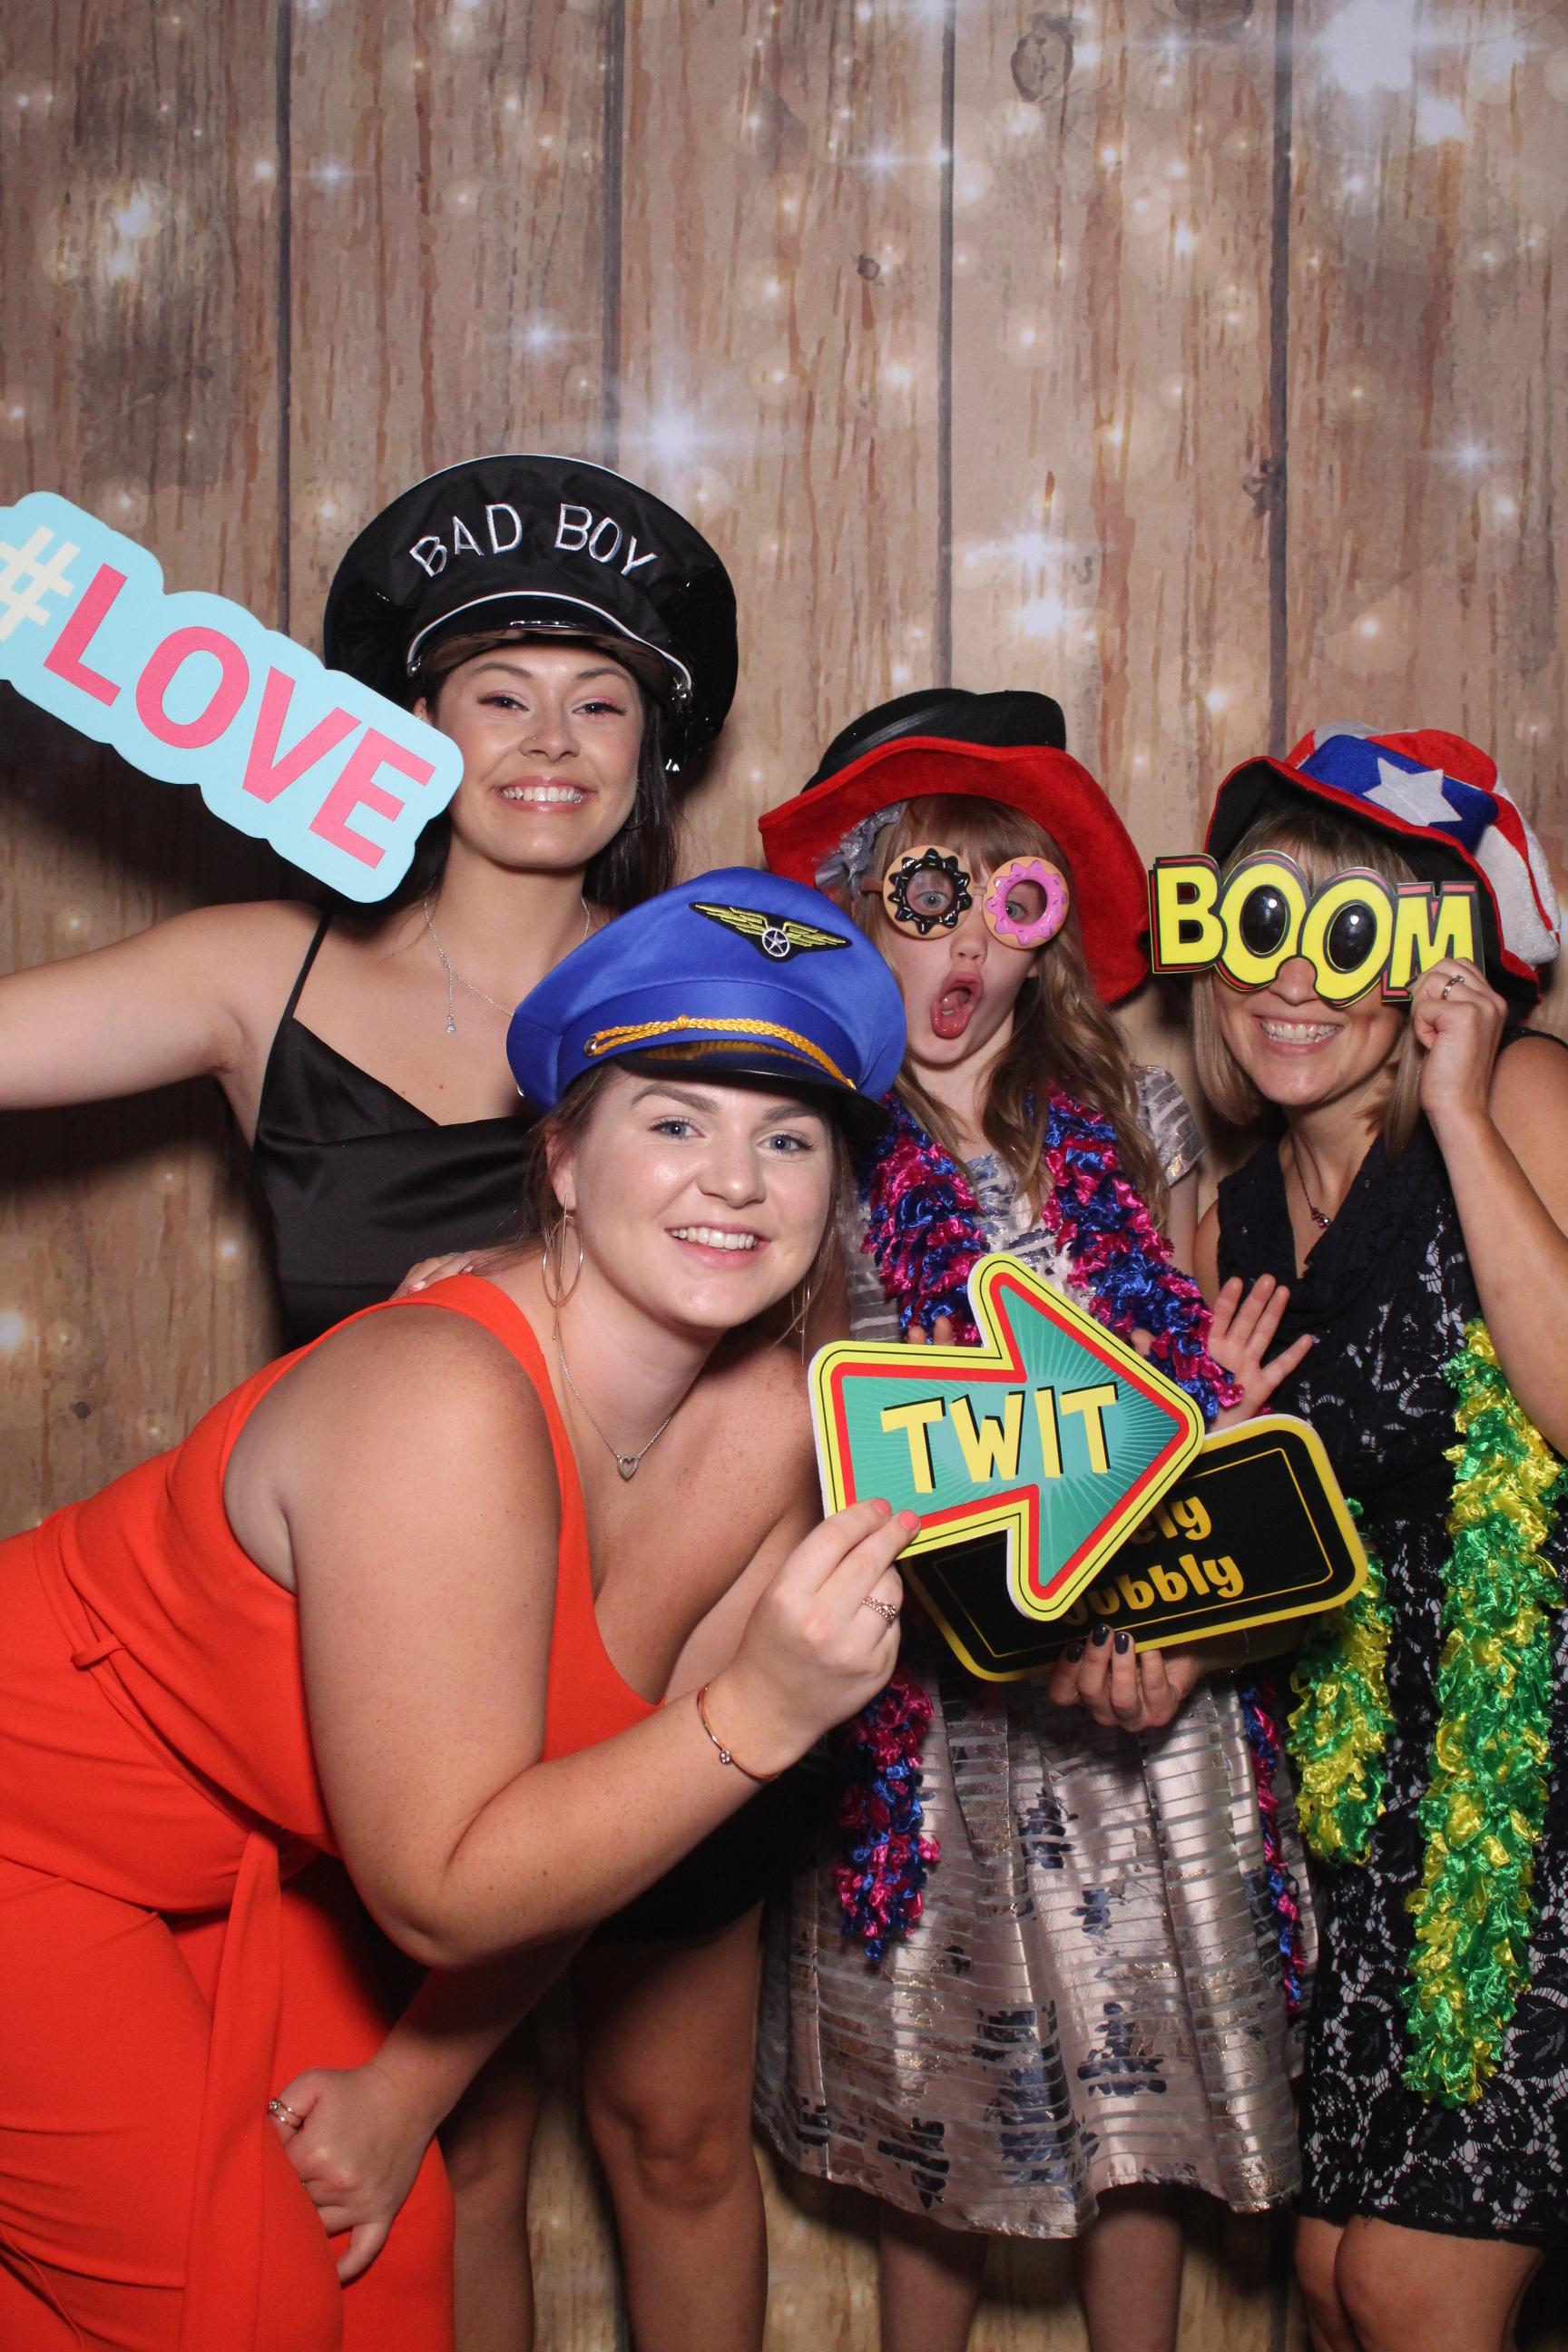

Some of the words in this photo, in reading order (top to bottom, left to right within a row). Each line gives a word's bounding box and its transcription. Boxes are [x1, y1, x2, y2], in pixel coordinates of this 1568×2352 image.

[409, 503, 523, 577] BAD
[554, 503, 658, 576] BOY
[1157, 862, 1475, 1002] BOOM
[880, 1382, 1118, 1494] TWIT
